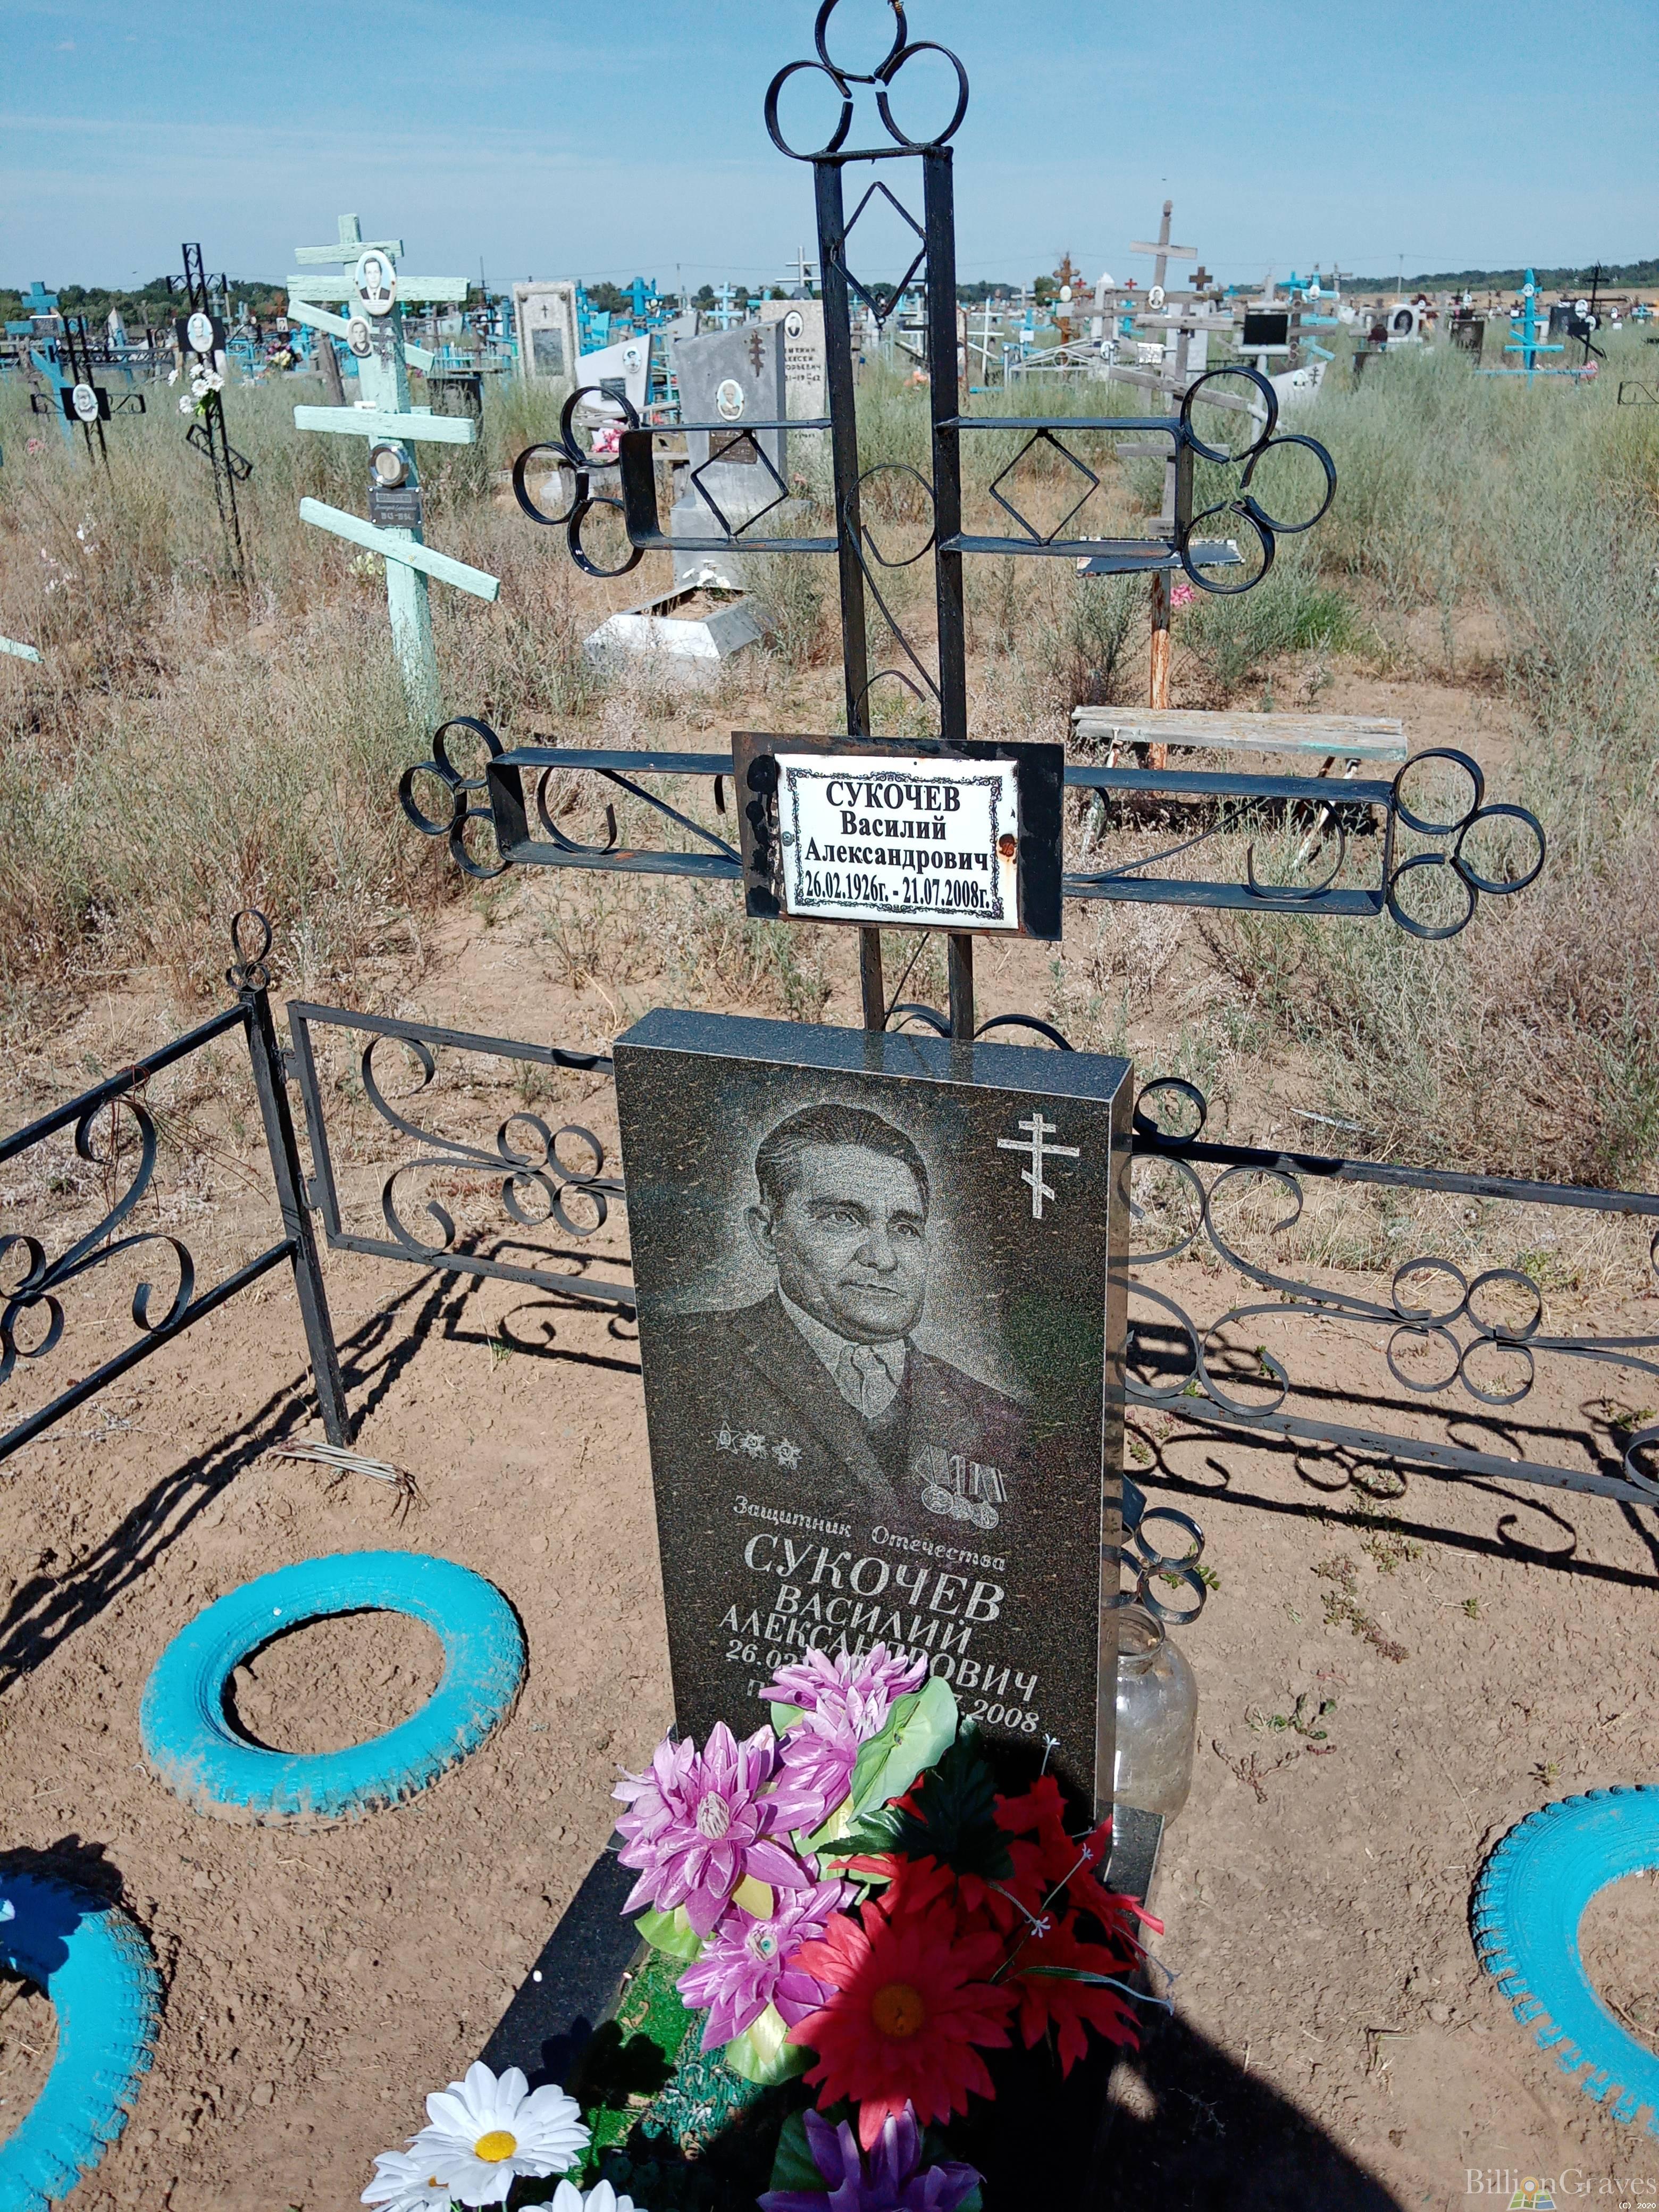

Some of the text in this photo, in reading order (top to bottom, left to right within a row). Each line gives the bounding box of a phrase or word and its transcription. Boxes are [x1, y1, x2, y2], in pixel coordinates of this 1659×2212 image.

[826, 781, 961, 811] СУКОЧЕВ
[840, 810, 946, 840] Василий
[805, 837, 989, 875] Александрович
[805, 870, 889, 902] 26.02.1926г.
[903, 876, 990, 908] 21.07.2008г.
[733, 1495, 1007, 1571] Защитник Отечества
[744, 1532, 1006, 1623] СУКОЧЕВ
[774, 1583, 973, 1654] ВАСИЛИЙ
